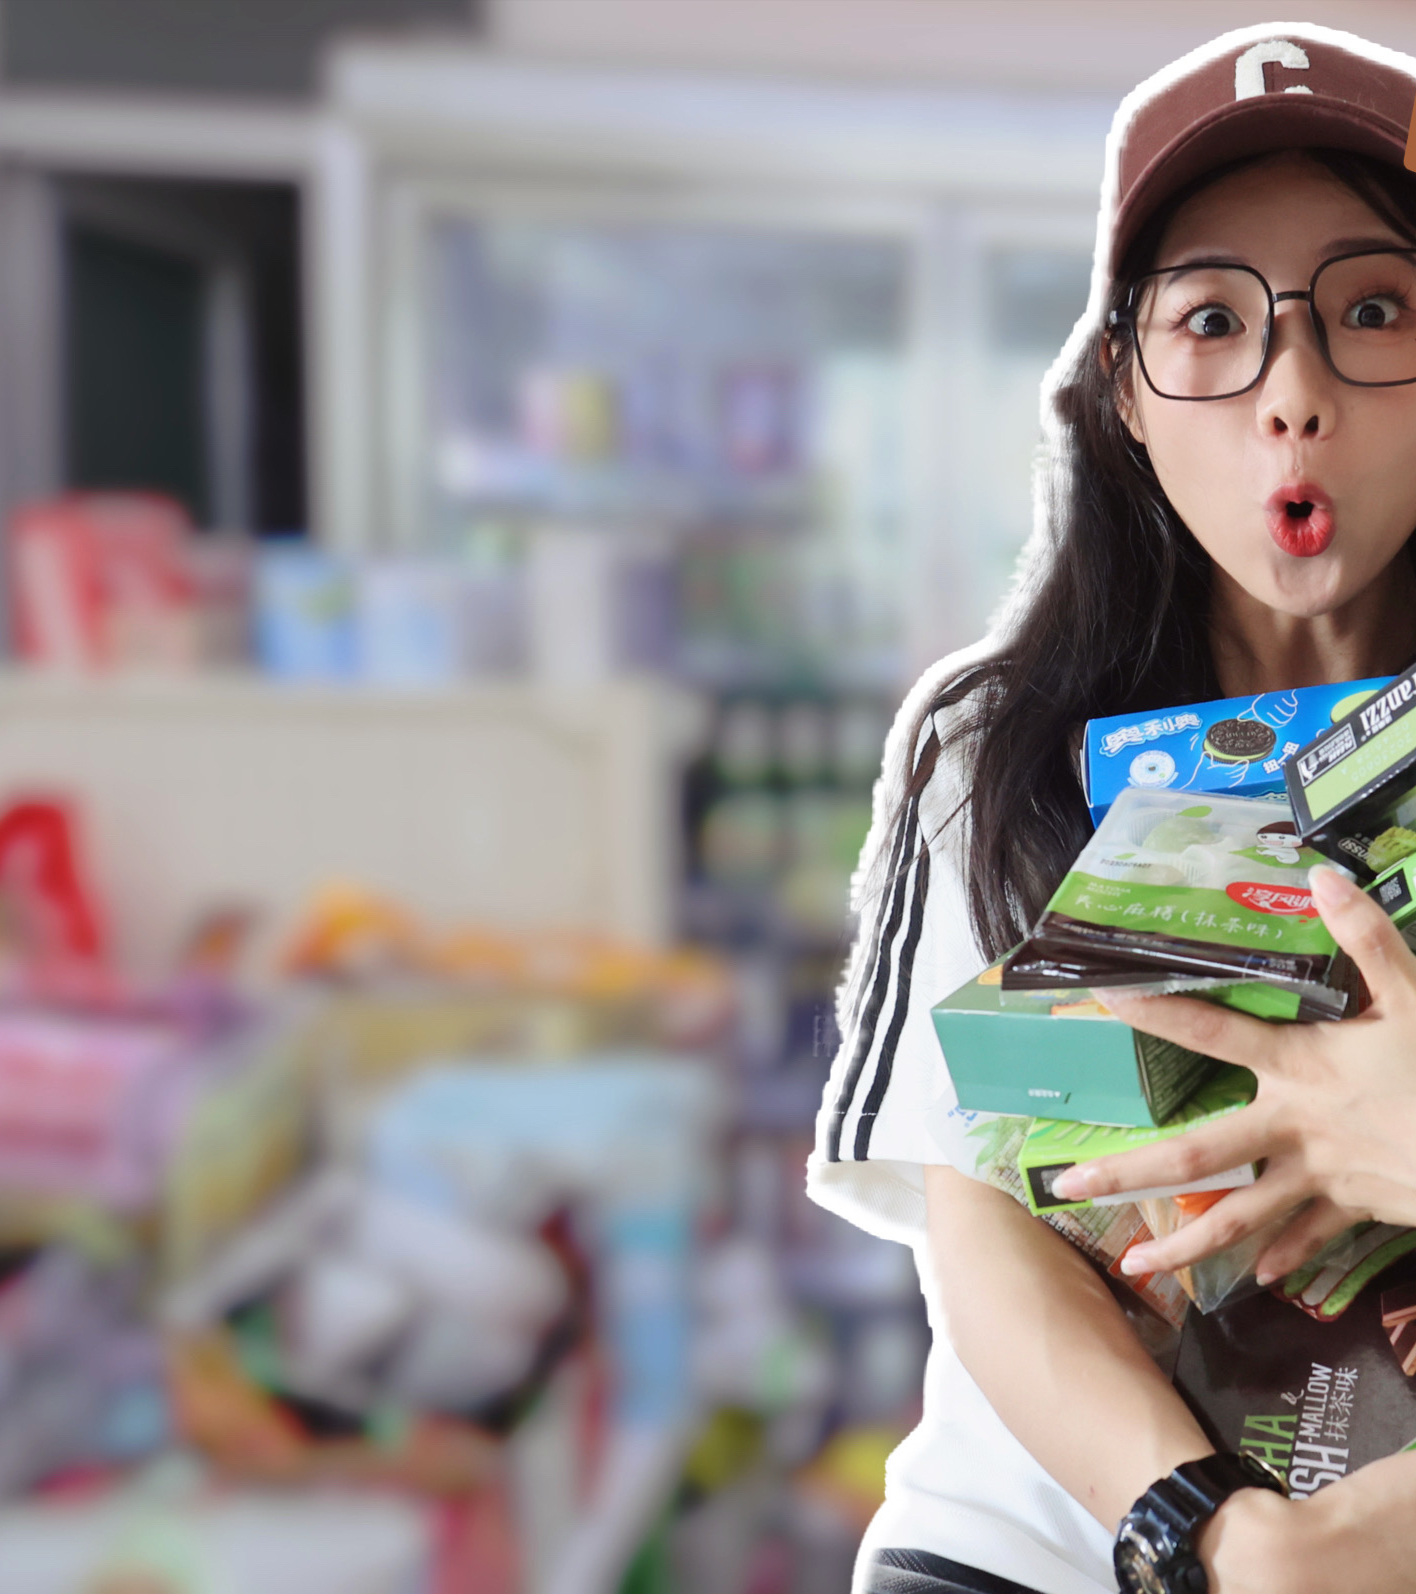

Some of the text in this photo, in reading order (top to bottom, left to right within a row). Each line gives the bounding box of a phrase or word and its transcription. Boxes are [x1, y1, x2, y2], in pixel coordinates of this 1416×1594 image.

[1103, 712, 1201, 753] 奥利奥
[1262, 741, 1300, 774] 扭一扭
[1323, 1366, 1359, 1442] 抹茶味
[1239, 1414, 1297, 1477] HA
